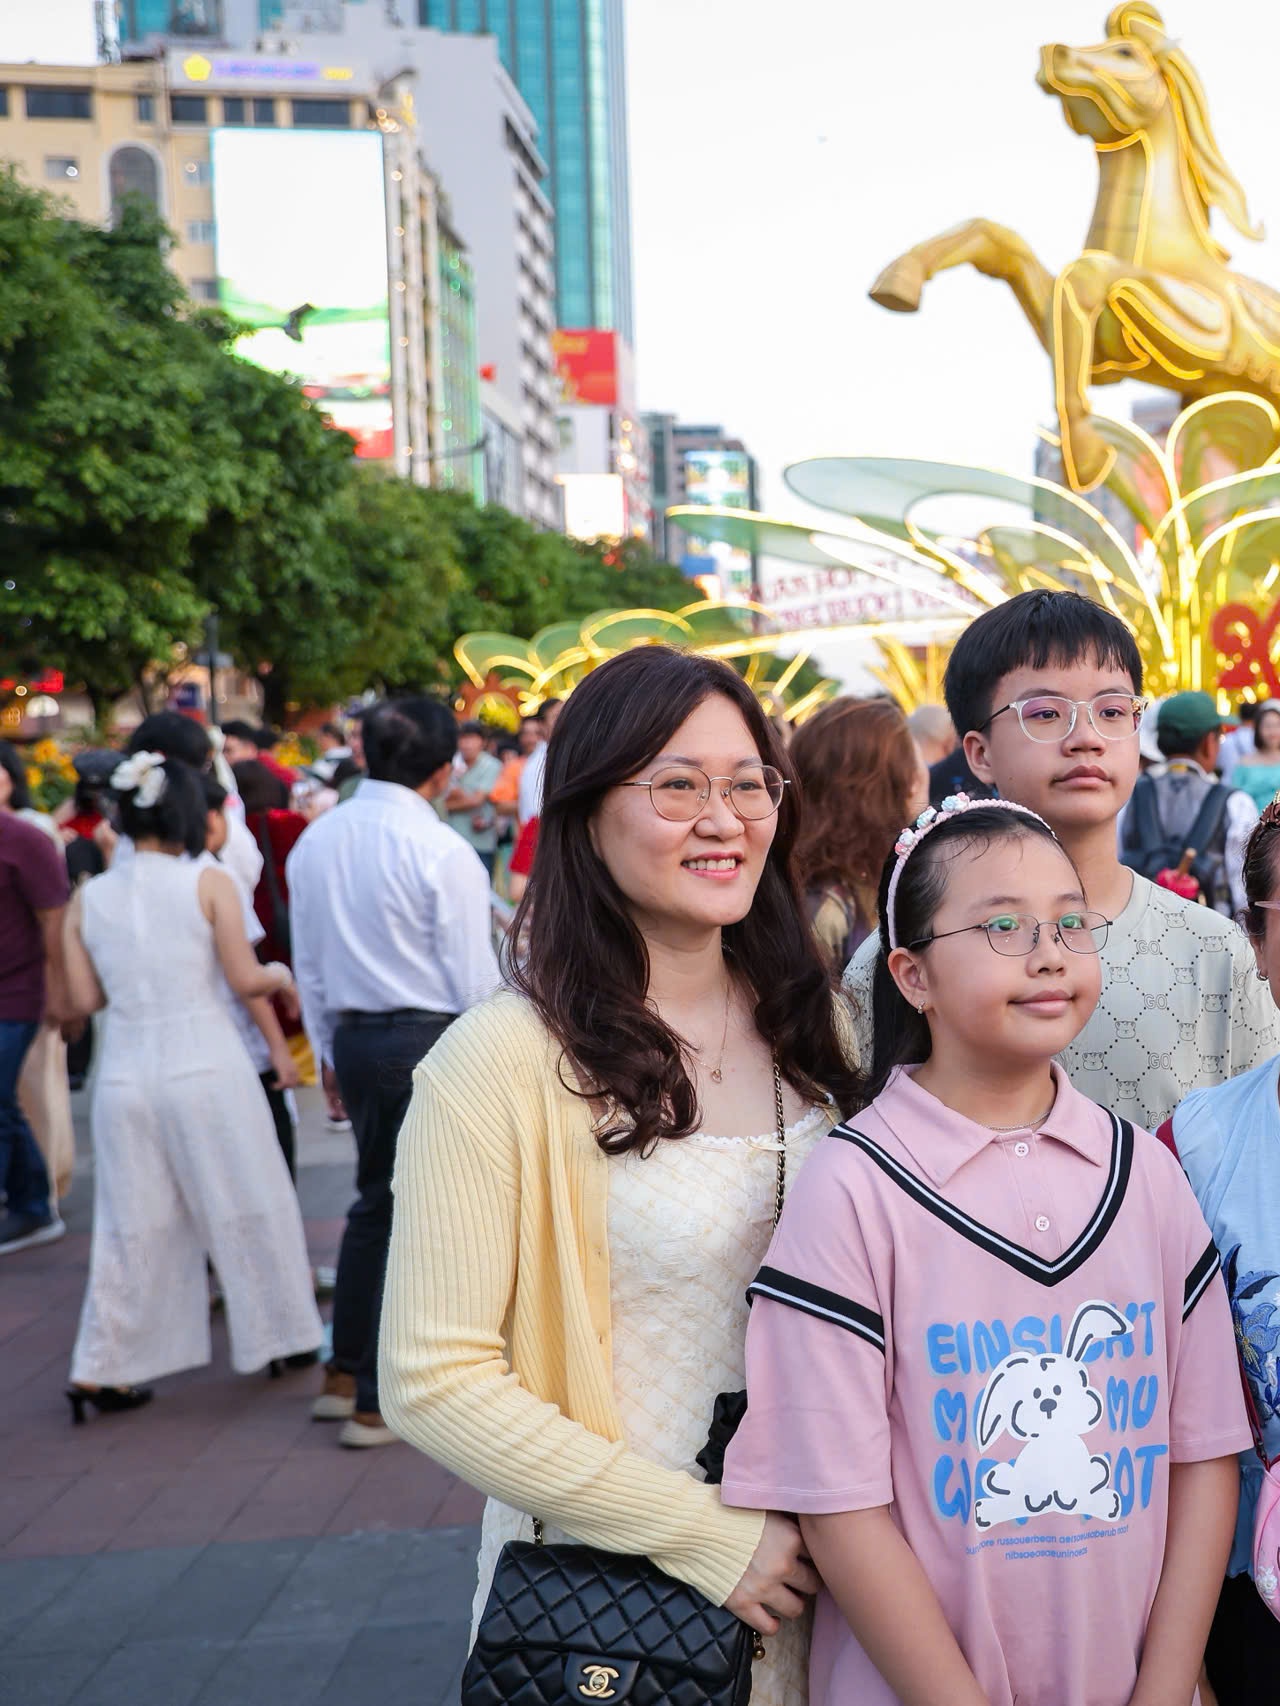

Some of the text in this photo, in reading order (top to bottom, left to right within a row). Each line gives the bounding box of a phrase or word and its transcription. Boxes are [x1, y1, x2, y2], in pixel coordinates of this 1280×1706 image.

[1136, 940, 1161, 955] GO
[1144, 994, 1168, 1010] GO
[1148, 1052, 1171, 1069] GO
[1106, 1375, 1158, 1433] MU
